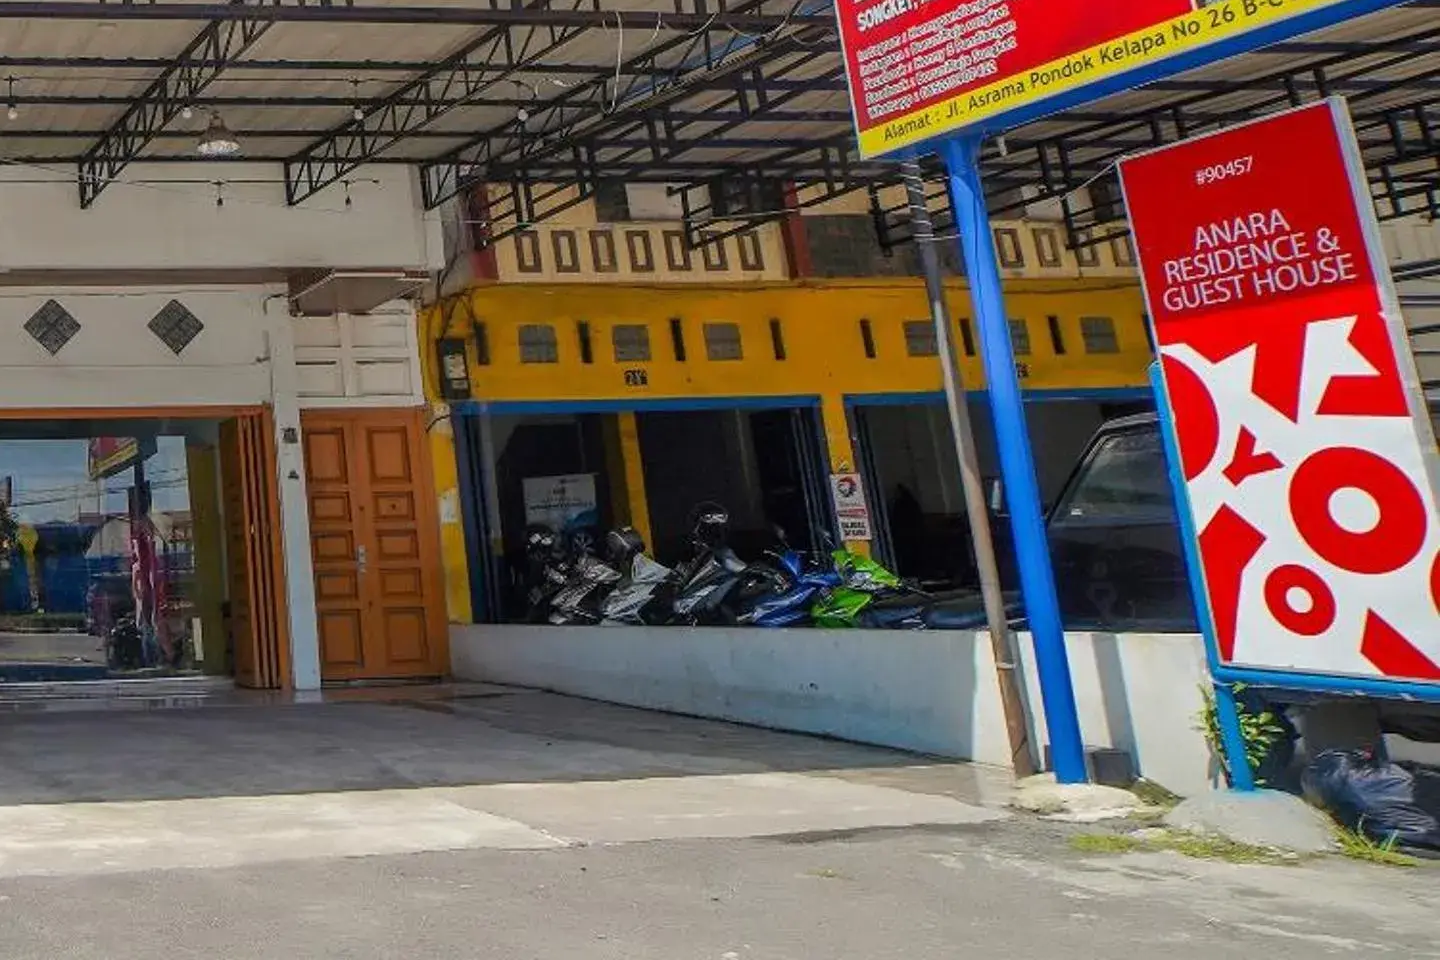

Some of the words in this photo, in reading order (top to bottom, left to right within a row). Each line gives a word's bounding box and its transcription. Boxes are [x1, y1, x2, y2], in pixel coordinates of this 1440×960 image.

[883, 113, 931, 142] Alamat
[968, 80, 1026, 111] Asrama
[1030, 54, 1095, 89] Pondok
[1099, 29, 1166, 65] Kelapa
[1171, 18, 1201, 40] No
[1210, 6, 1236, 28] 26
[1195, 155, 1253, 185] #90457
[1164, 231, 1311, 284] RESIDENCE
[1316, 227, 1341, 254] &
[1194, 207, 1291, 251] ANARA
[1162, 273, 1245, 312] GUEST
[1252, 252, 1358, 296] HOUSE
